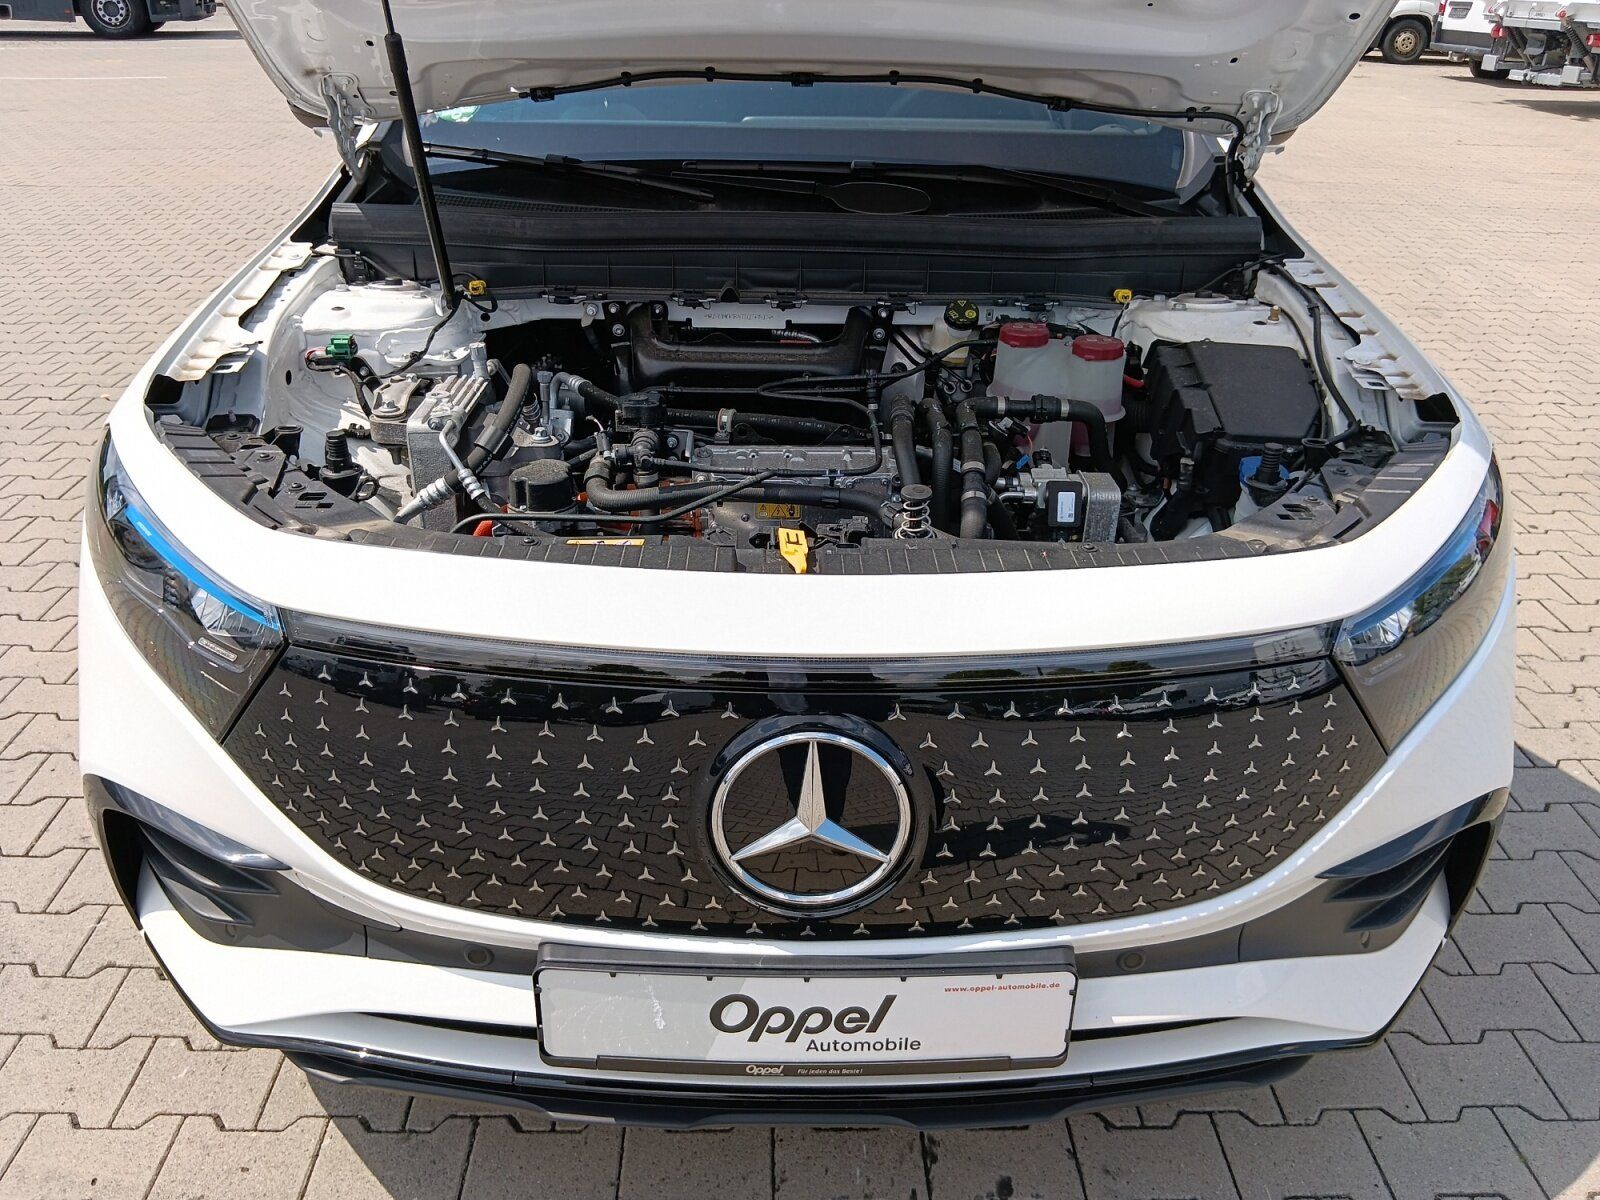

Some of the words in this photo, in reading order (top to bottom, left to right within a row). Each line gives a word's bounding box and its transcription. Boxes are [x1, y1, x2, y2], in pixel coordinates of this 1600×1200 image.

[944, 982, 1061, 993] www.oppel-automobile.de
[709, 993, 898, 1043] Oppel
[805, 1037, 922, 1052] Automobile
[745, 1064, 784, 1076] Oppel
